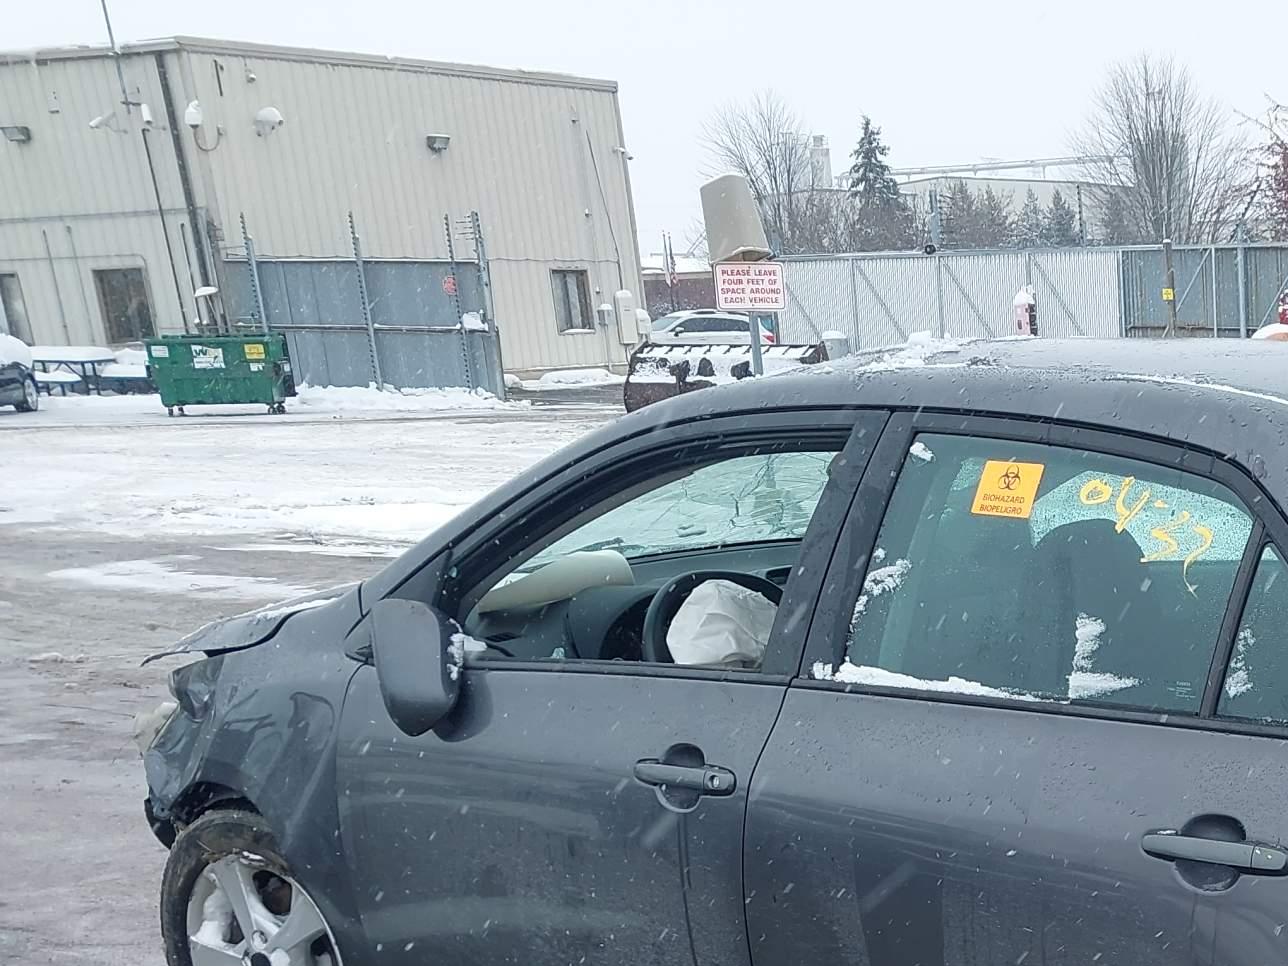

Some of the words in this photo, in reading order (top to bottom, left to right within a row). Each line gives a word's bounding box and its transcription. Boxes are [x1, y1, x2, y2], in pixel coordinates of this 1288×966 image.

[721, 269, 751, 277] PLEASE
[754, 269, 777, 277] LEAVE
[722, 278, 743, 286] FOUR
[747, 278, 764, 286] FEET
[768, 278, 777, 286] OF
[720, 287, 746, 295] SPACE
[749, 287, 781, 295] AROUND
[724, 296, 746, 304] EACH
[749, 296, 780, 304] VEHICLE
[982, 493, 1025, 504] BIOHAZARD
[979, 503, 1023, 515] BIOPELIGRO
